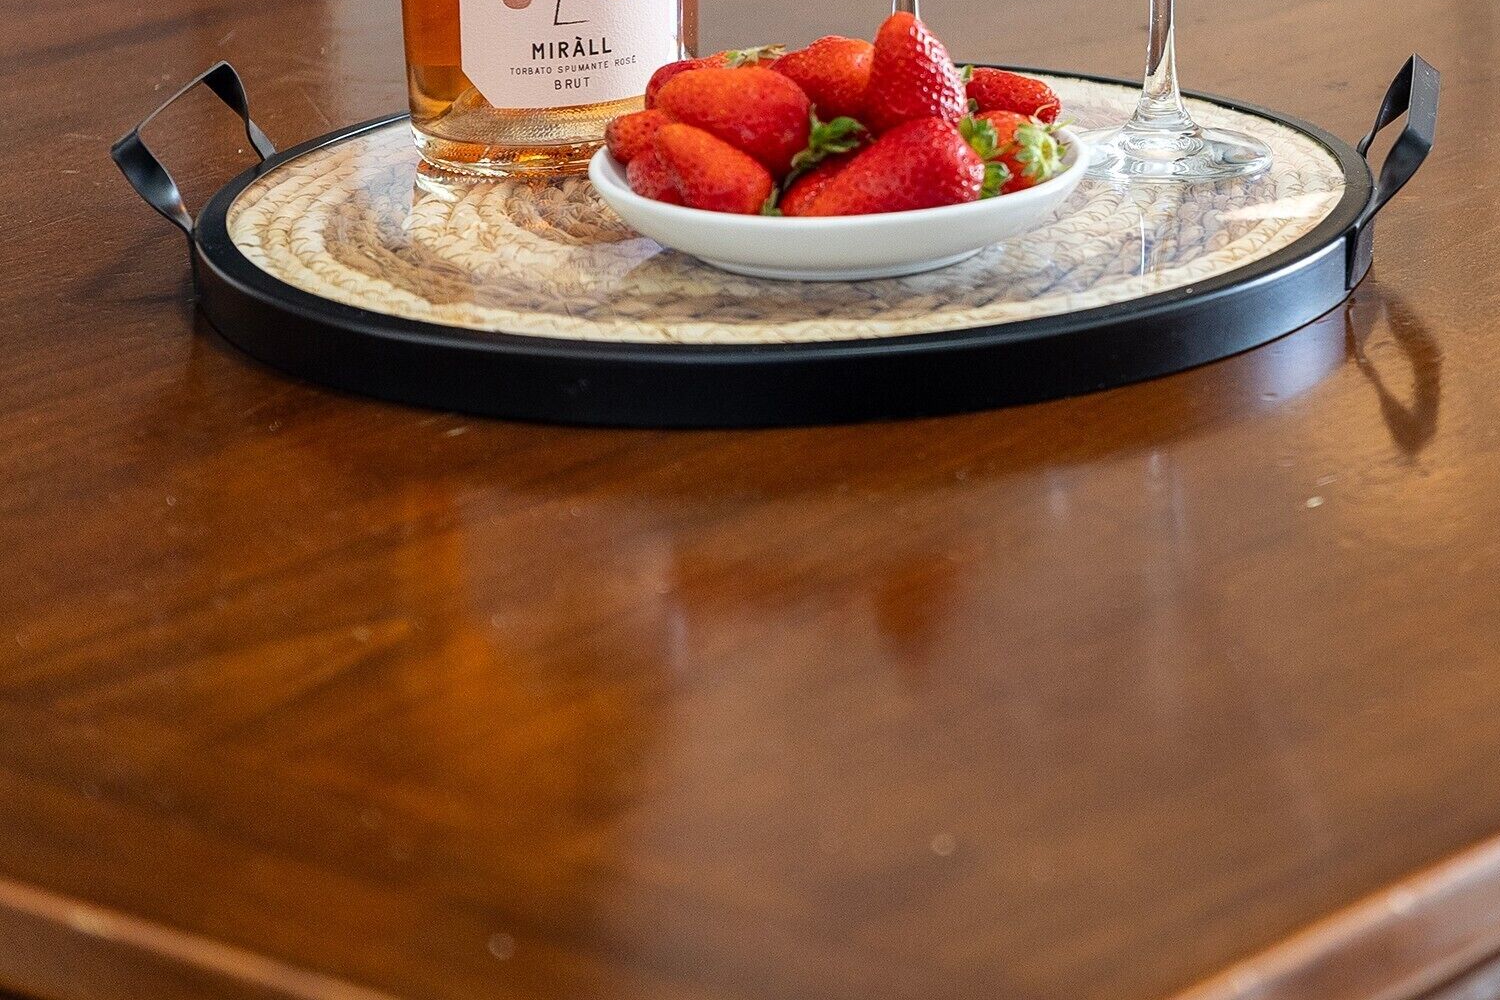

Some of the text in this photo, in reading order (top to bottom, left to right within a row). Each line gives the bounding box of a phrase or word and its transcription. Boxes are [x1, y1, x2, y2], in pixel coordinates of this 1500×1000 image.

[531, 36, 612, 60] MIRÀLL
[510, 54, 637, 76] TORBATO SPUMANTE ROSÉ
[554, 77, 590, 90] BRUT
